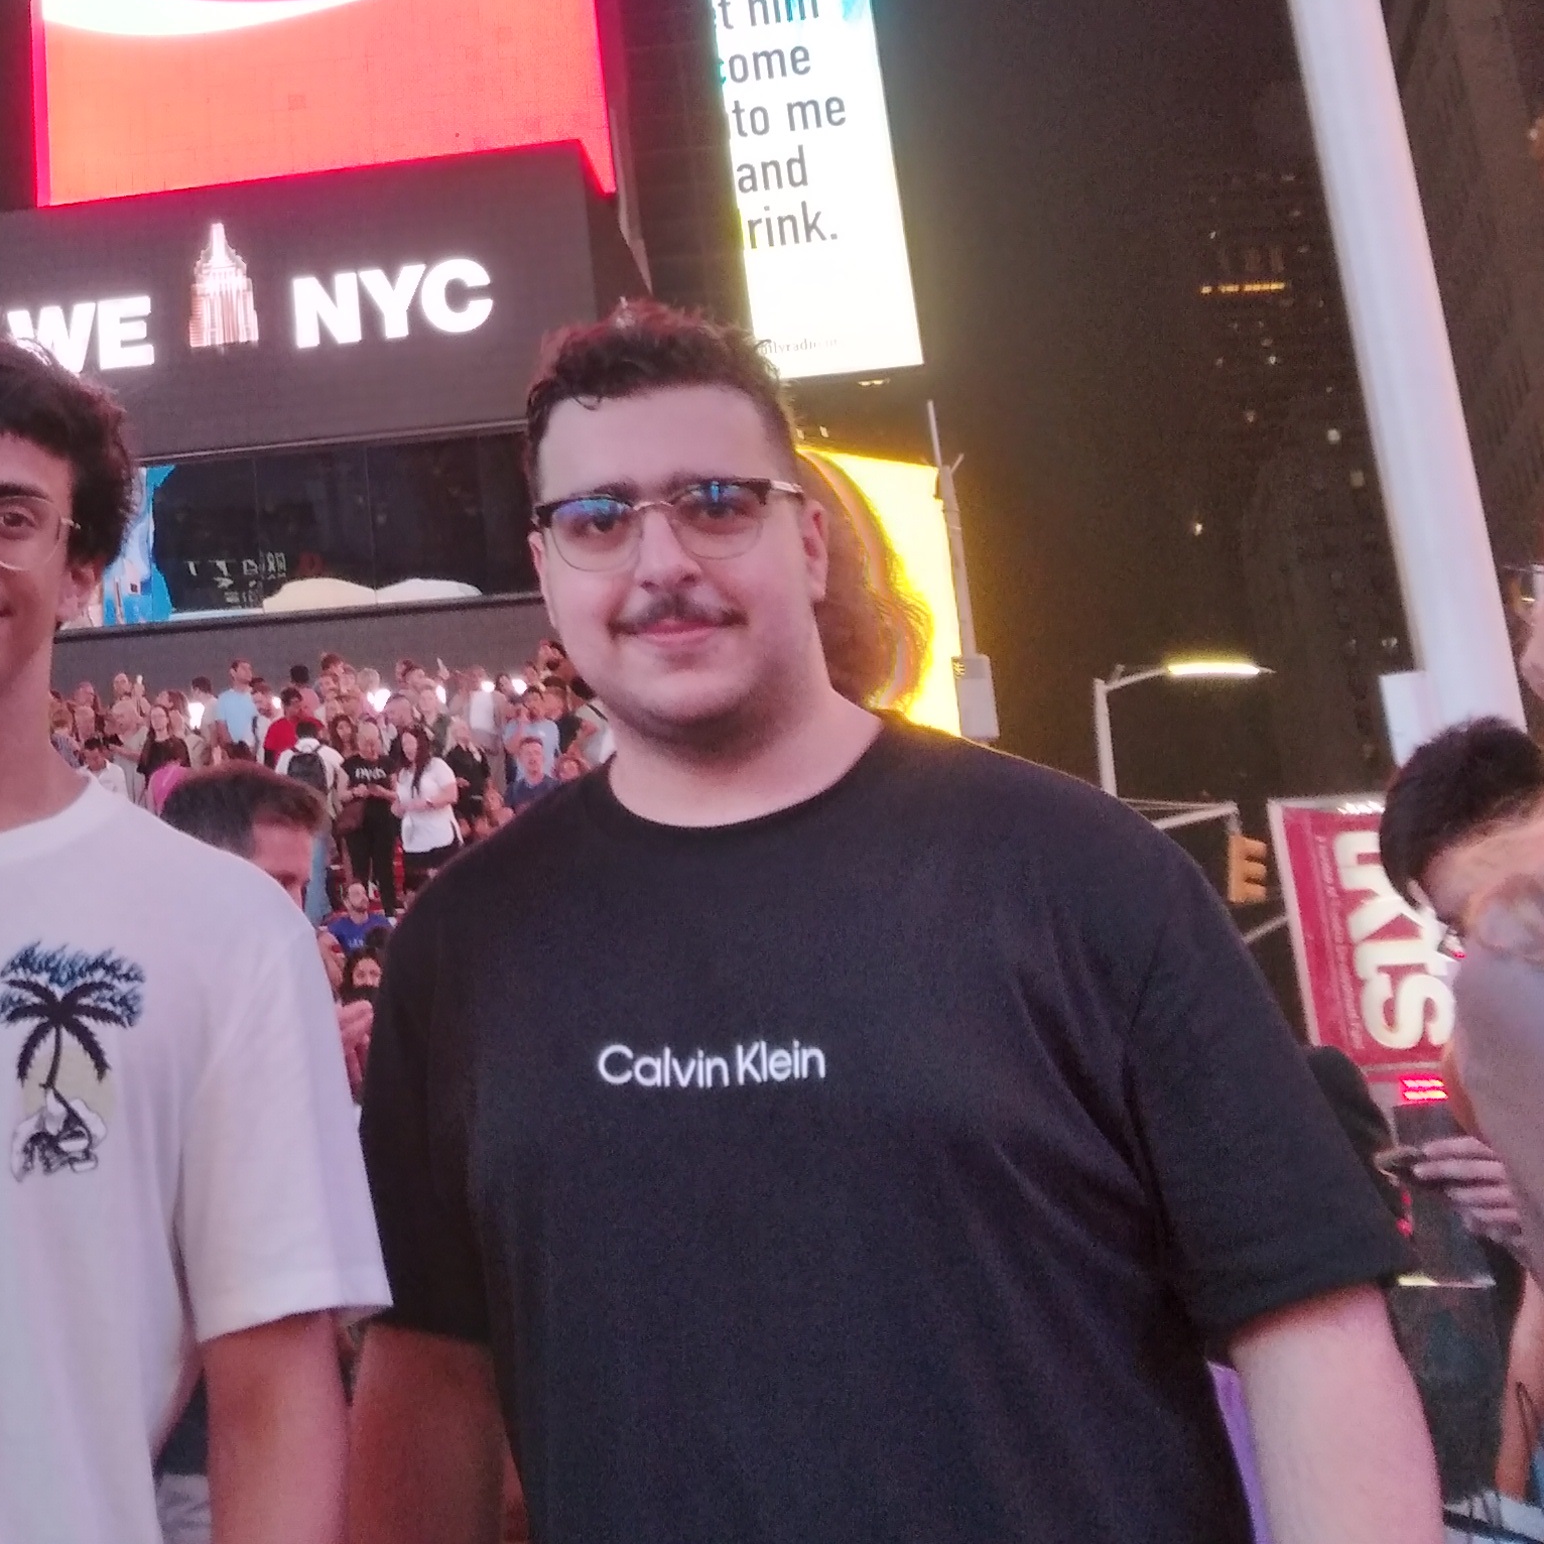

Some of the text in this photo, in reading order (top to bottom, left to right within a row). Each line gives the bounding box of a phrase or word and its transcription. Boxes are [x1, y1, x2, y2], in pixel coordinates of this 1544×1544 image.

[731, 96, 847, 138] to me
[736, 144, 809, 194] and
[7, 258, 494, 375] WE NYC
[597, 1037, 826, 1088] Calvin Klein
